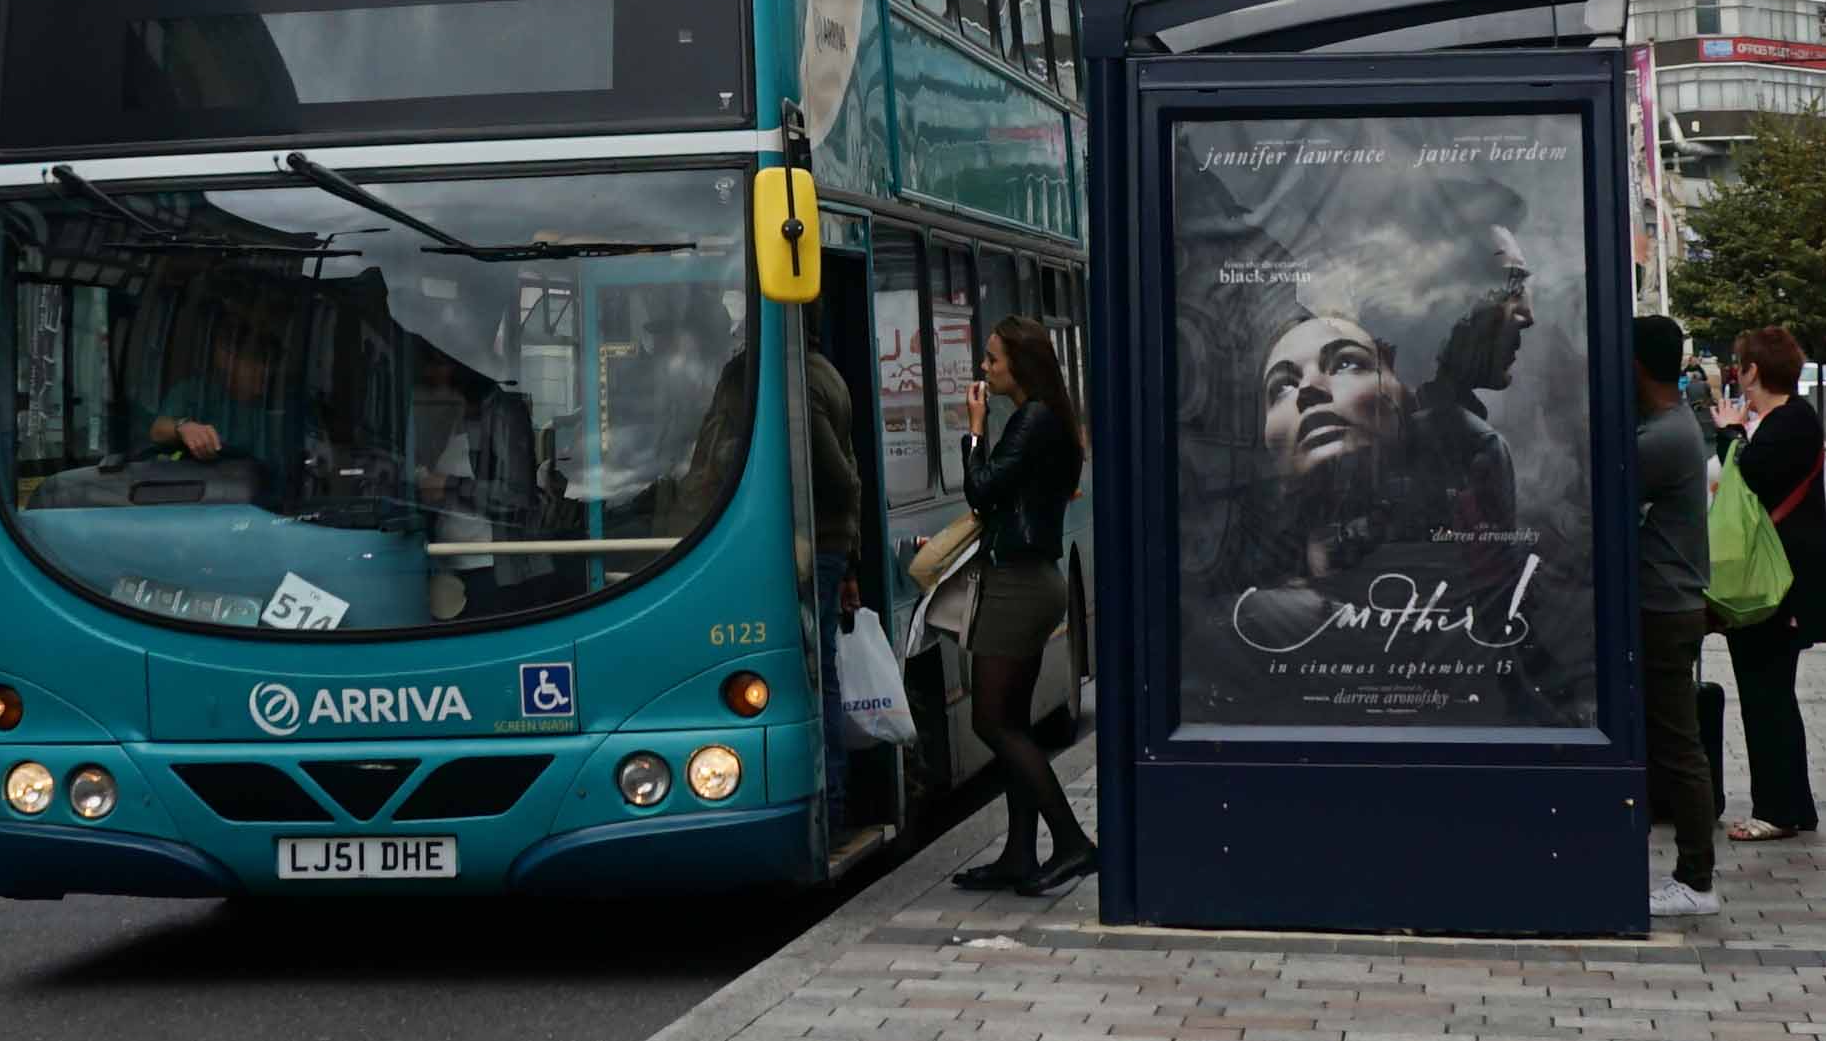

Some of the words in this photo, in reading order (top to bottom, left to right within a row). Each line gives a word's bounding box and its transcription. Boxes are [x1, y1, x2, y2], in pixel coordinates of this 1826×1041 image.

[1199, 146, 1287, 172] jennifer
[1294, 144, 1385, 165] lawrence
[1413, 143, 1481, 168] javier
[1489, 140, 1567, 161] bardem
[1219, 268, 1265, 284] black
[1233, 553, 1540, 652] mother!
[710, 623, 766, 645] 6123
[1269, 660, 1288, 674] in
[1300, 659, 1376, 675] cinemas
[1387, 659, 1485, 679] september
[1495, 659, 1514, 674] 15
[308, 686, 473, 724] ARRIVA
[1332, 687, 1379, 705] darren
[290, 842, 365, 872] LJ51
[381, 841, 444, 871] DHE
